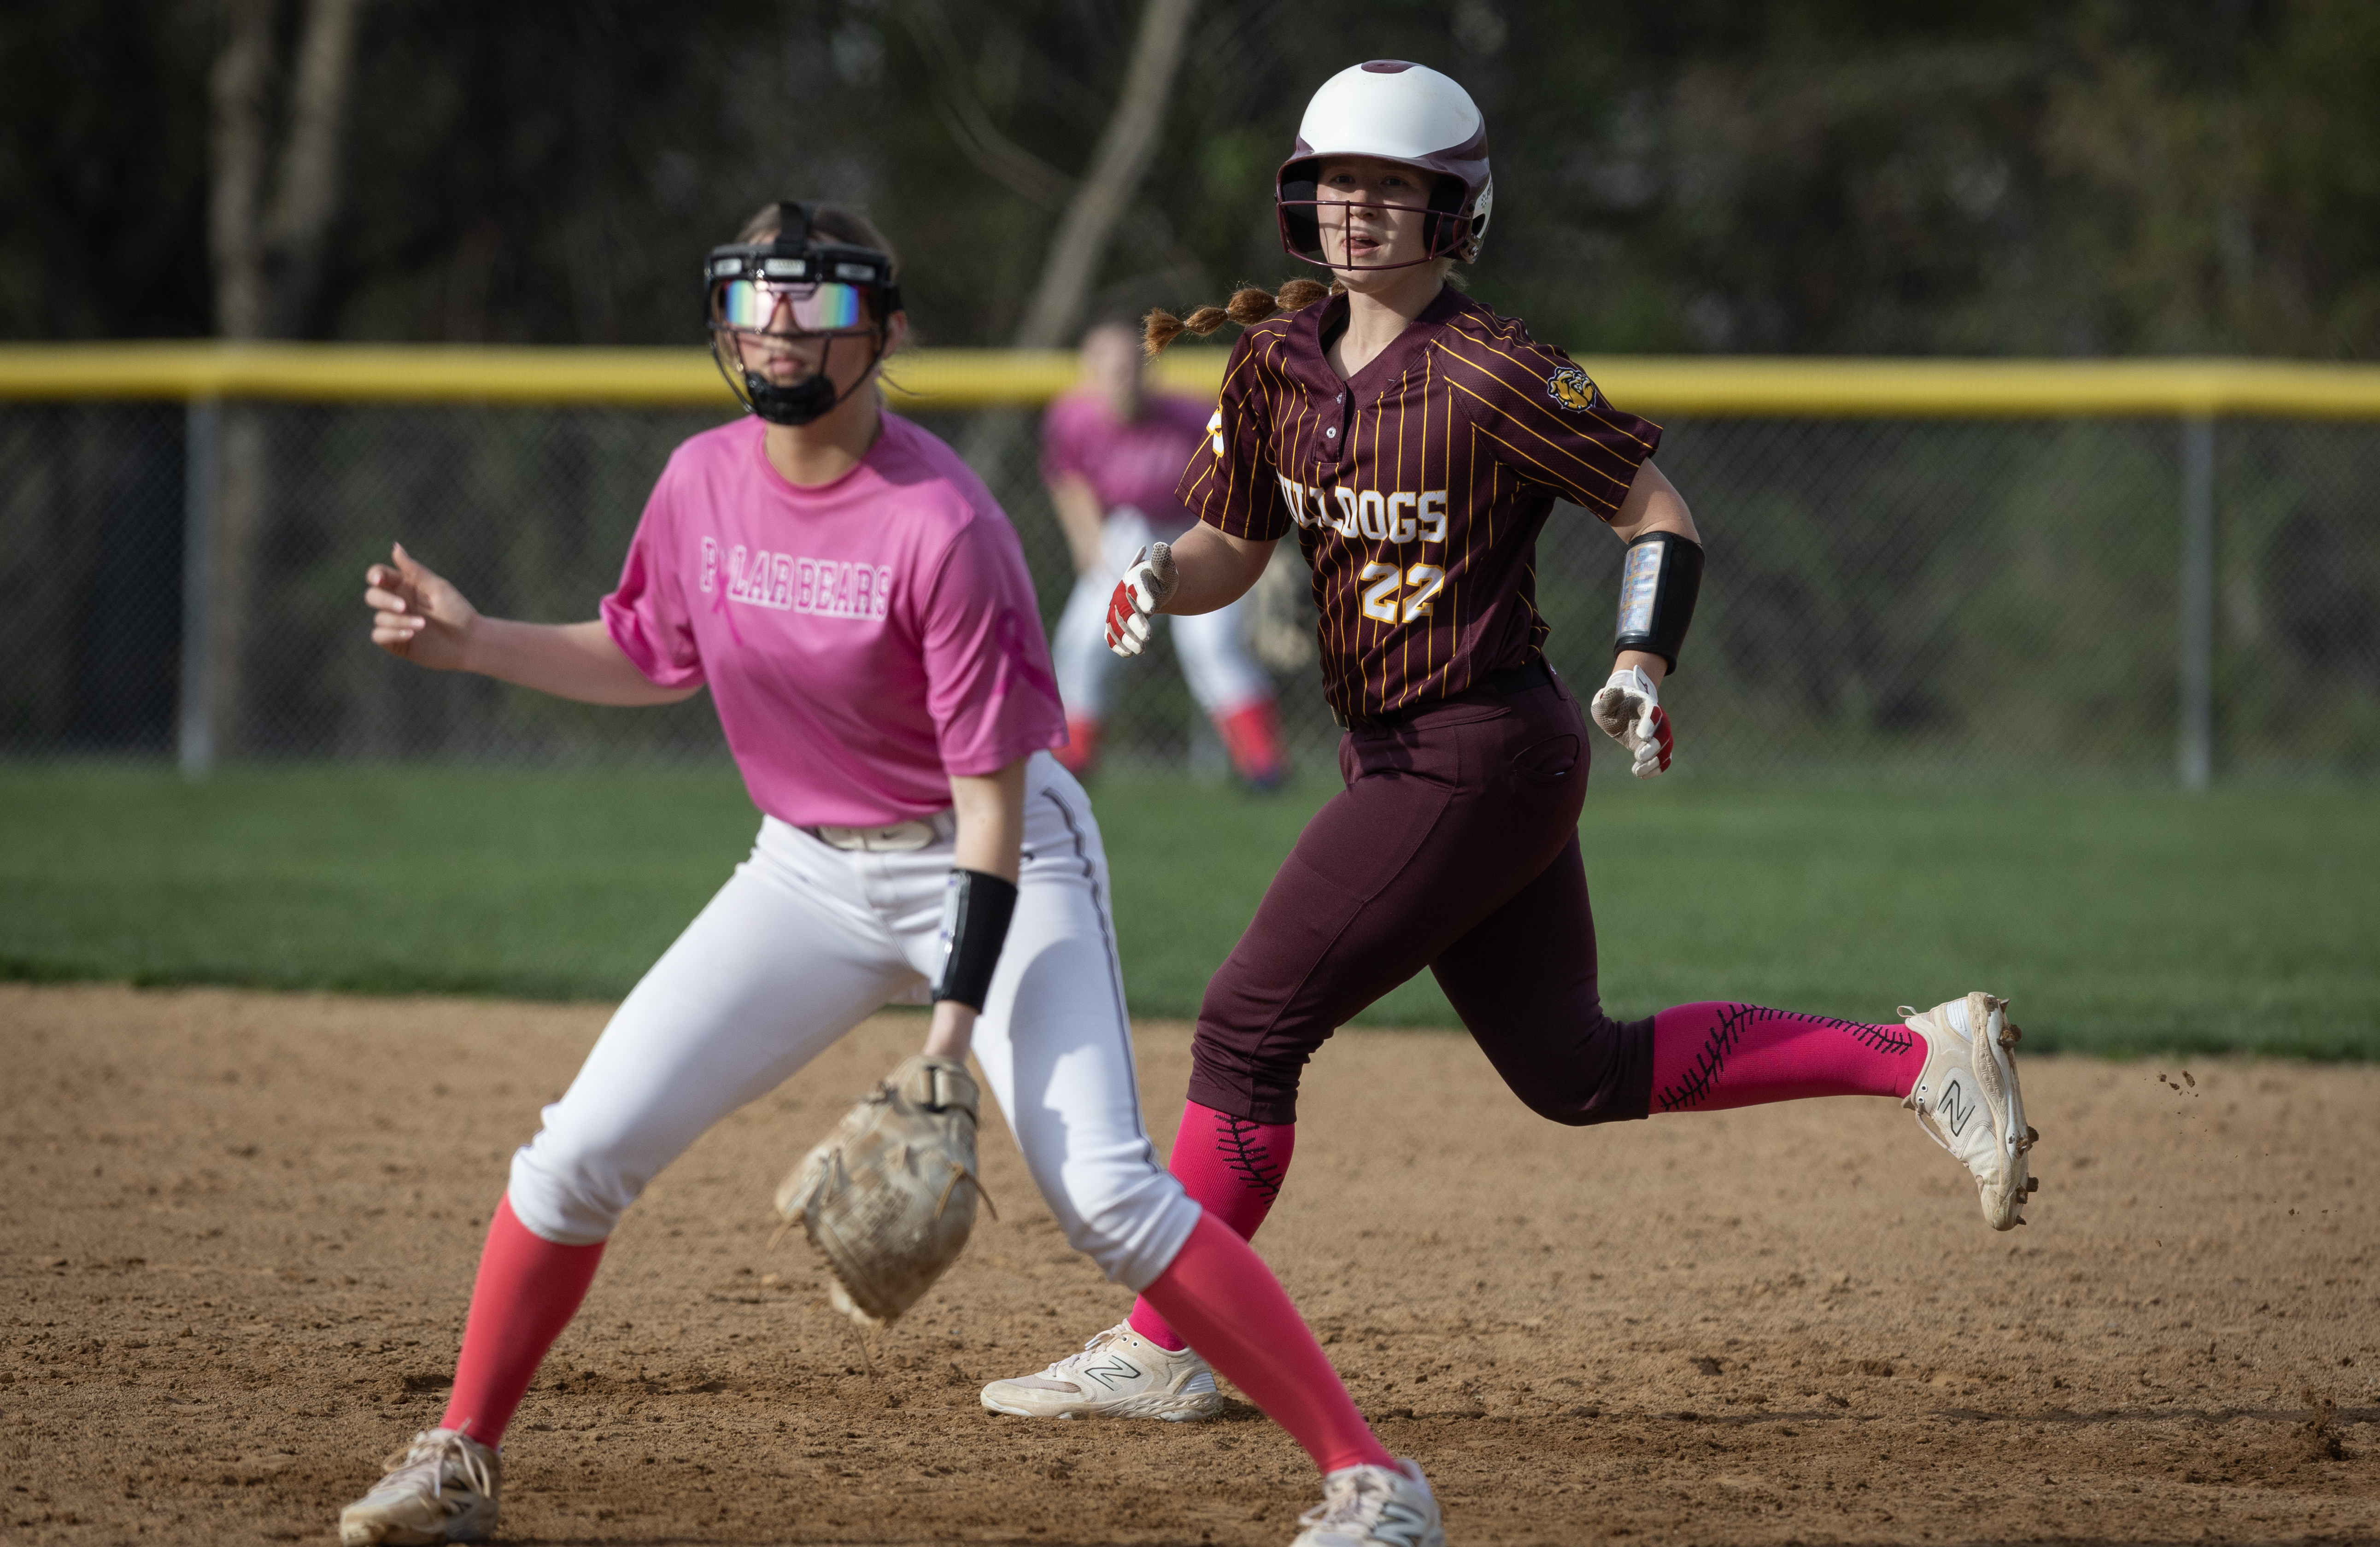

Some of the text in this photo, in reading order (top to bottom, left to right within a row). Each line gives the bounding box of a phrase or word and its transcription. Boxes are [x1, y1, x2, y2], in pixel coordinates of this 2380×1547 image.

[1276, 467, 1448, 544] ULLDOGS
[699, 535, 794, 611] PLAR
[1360, 560, 1446, 624] 22
